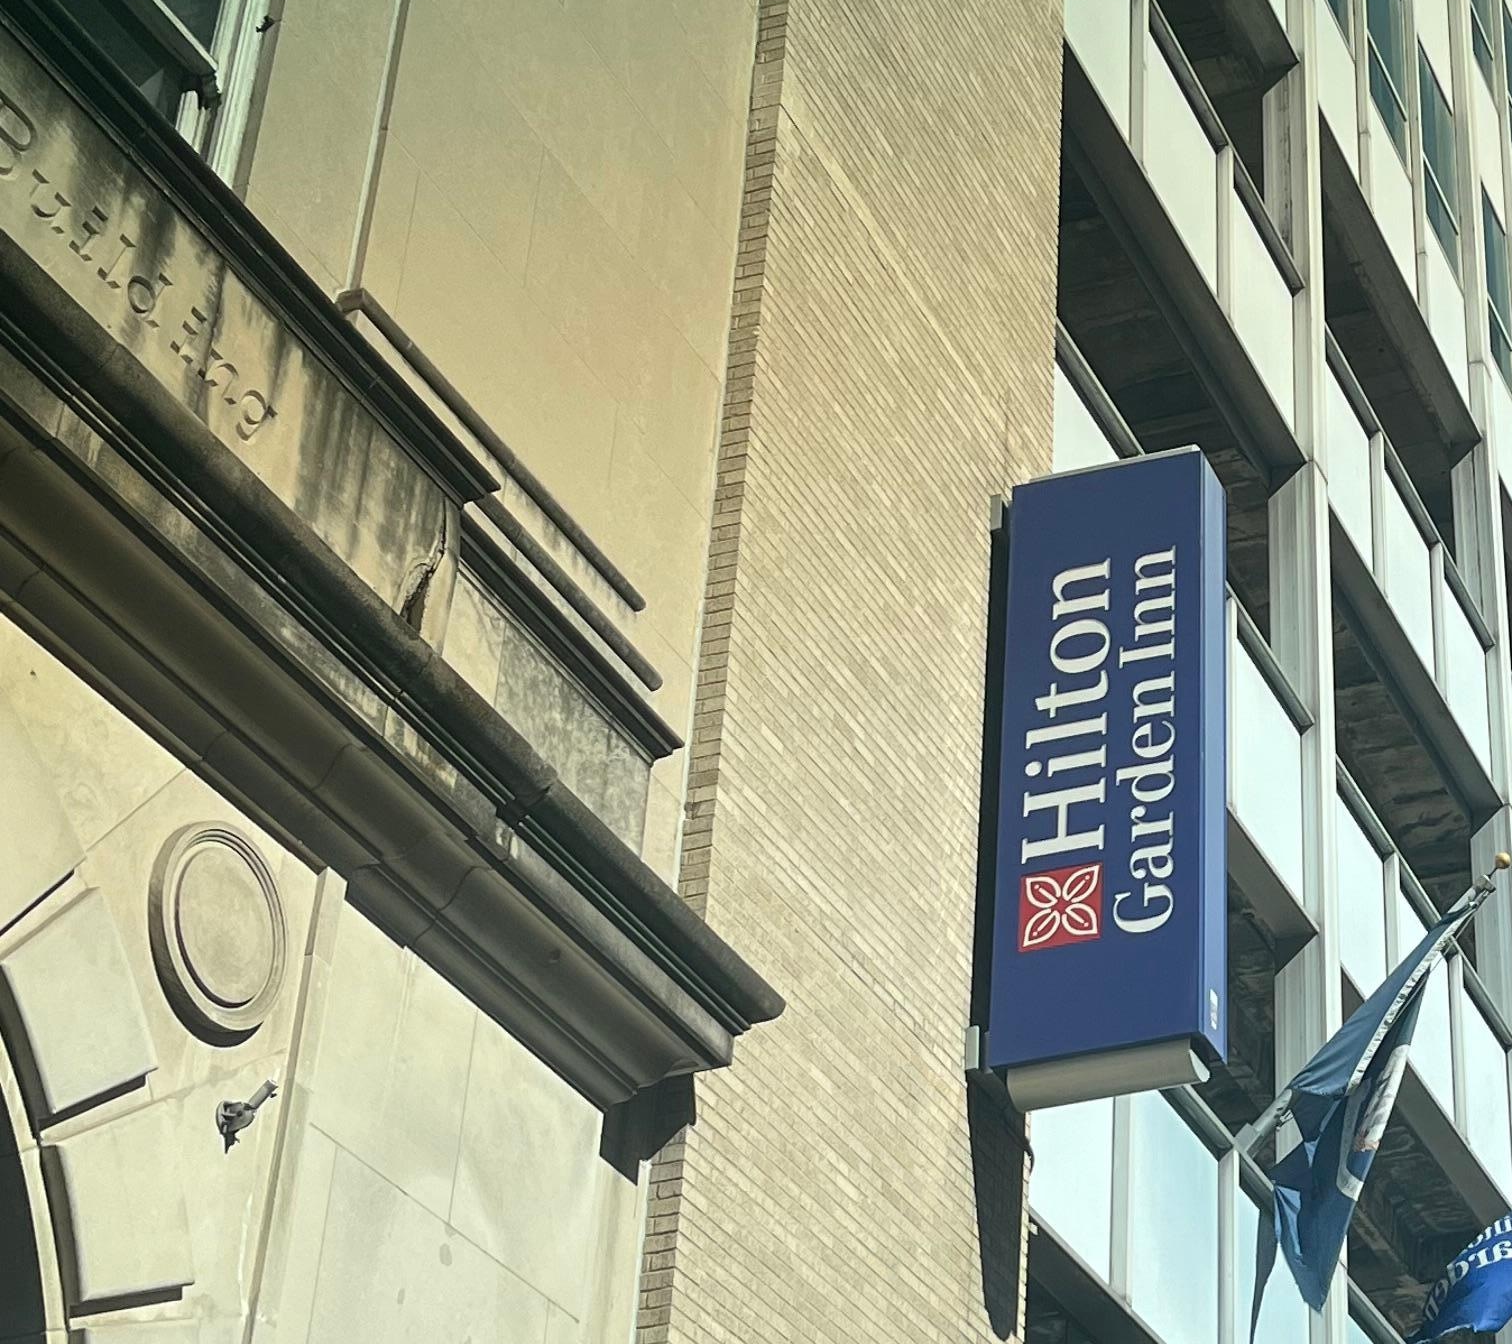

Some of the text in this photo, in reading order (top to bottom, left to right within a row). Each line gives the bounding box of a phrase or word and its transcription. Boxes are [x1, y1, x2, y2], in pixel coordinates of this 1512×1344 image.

[1020, 557, 1112, 865] Hilton
[1113, 544, 1178, 934] Garden Inn
